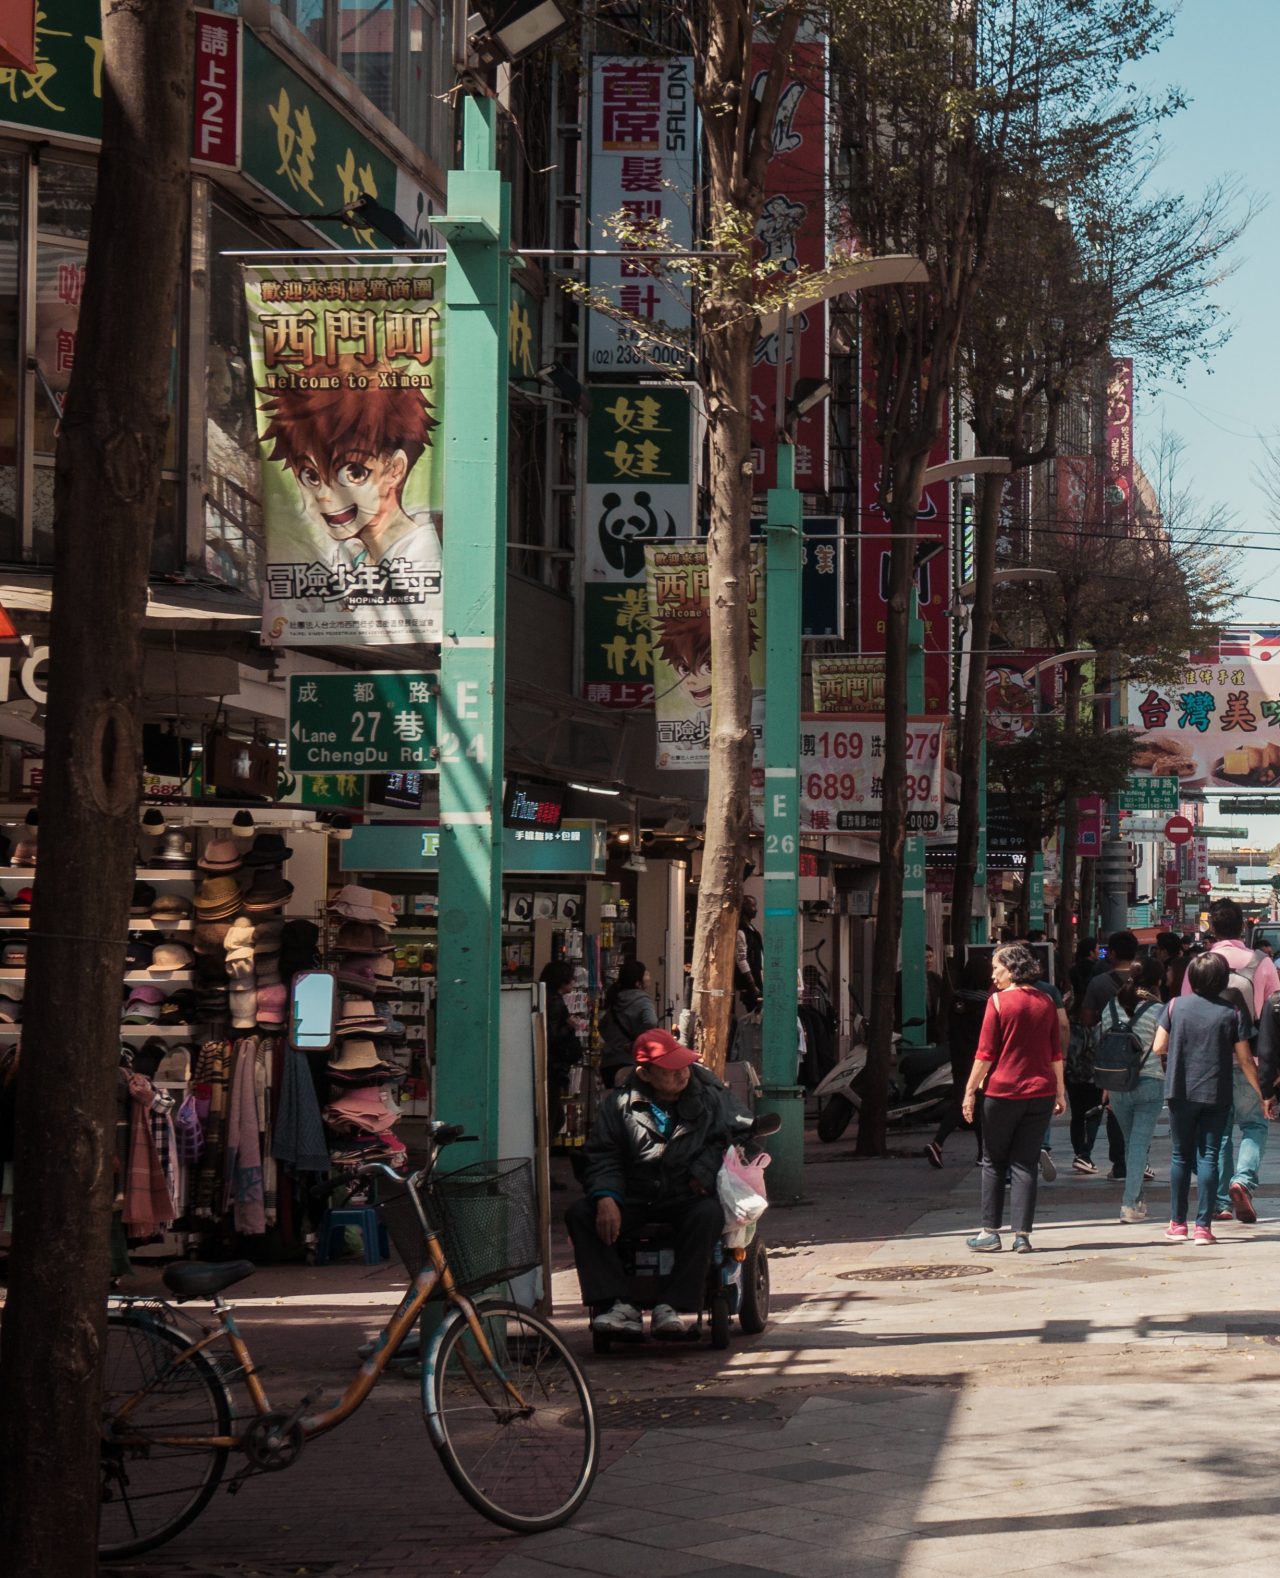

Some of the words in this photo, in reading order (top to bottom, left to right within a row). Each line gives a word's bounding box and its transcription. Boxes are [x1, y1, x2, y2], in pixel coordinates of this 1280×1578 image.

[200, 24, 229, 154] 請上2F
[666, 64, 687, 151] SALON
[261, 277, 433, 301] 歡迎來到優質商圈
[259, 307, 440, 368] 西門町
[592, 350, 614, 365] (02)
[266, 373, 340, 389] Welcome
[349, 374, 368, 389] to
[379, 372, 431, 388] Ximen
[605, 395, 672, 478] 娃娃
[387, 595, 415, 603] JONES
[298, 681, 430, 704] 成都路
[456, 681, 478, 719] E
[588, 684, 655, 702] 請上2
[302, 728, 336, 743] Lane
[351, 711, 381, 743] 27
[393, 710, 424, 742] 巷
[440, 732, 486, 763] 24
[819, 732, 863, 758] 169
[307, 749, 388, 765] ChengDu
[400, 749, 428, 762] Rd.
[807, 773, 856, 800] 689
[773, 794, 787, 817] E
[766, 835, 794, 854] 26
[907, 838, 917, 851] E
[904, 863, 922, 878] 28
